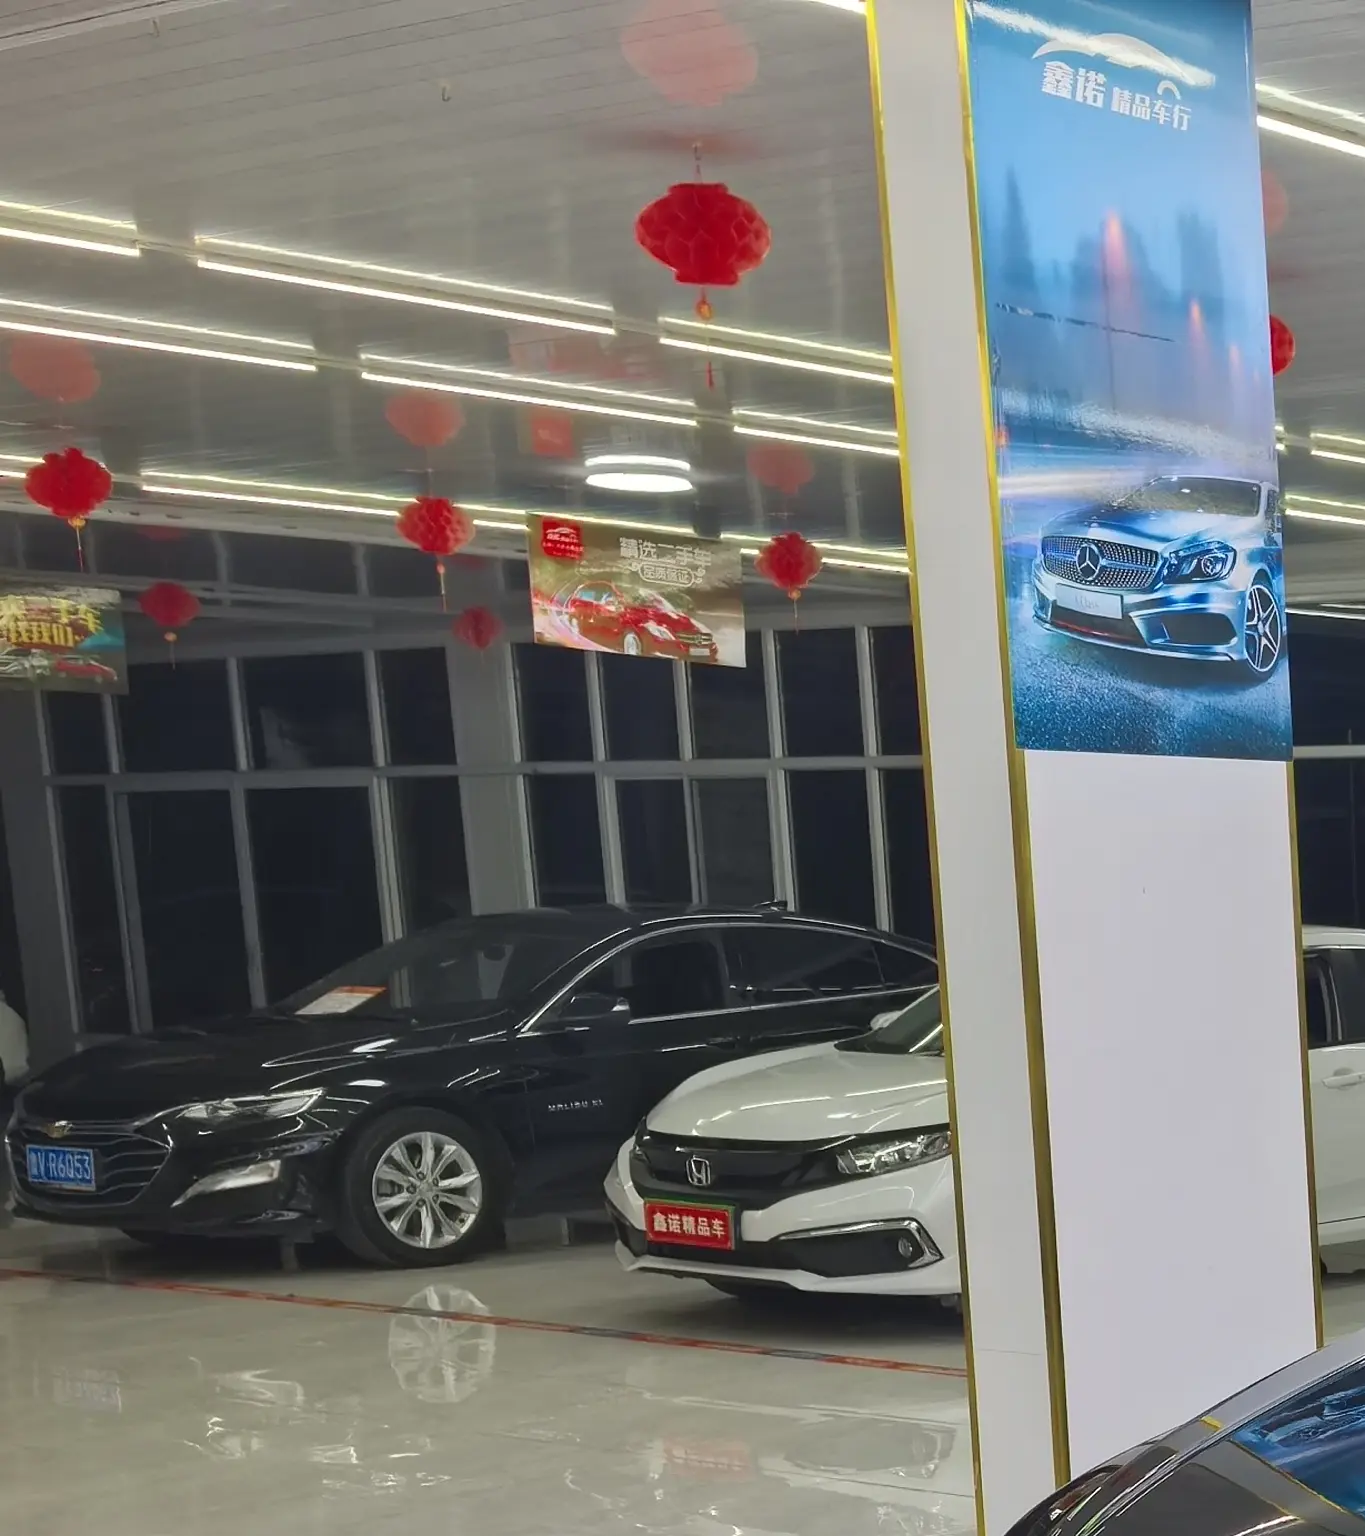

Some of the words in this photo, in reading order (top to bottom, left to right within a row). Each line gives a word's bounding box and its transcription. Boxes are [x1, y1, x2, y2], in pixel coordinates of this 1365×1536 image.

[1041, 60, 1107, 109] 鑫诺
[1110, 86, 1192, 131] 精品车行
[653, 1211, 726, 1239] 鑫诺精品车
